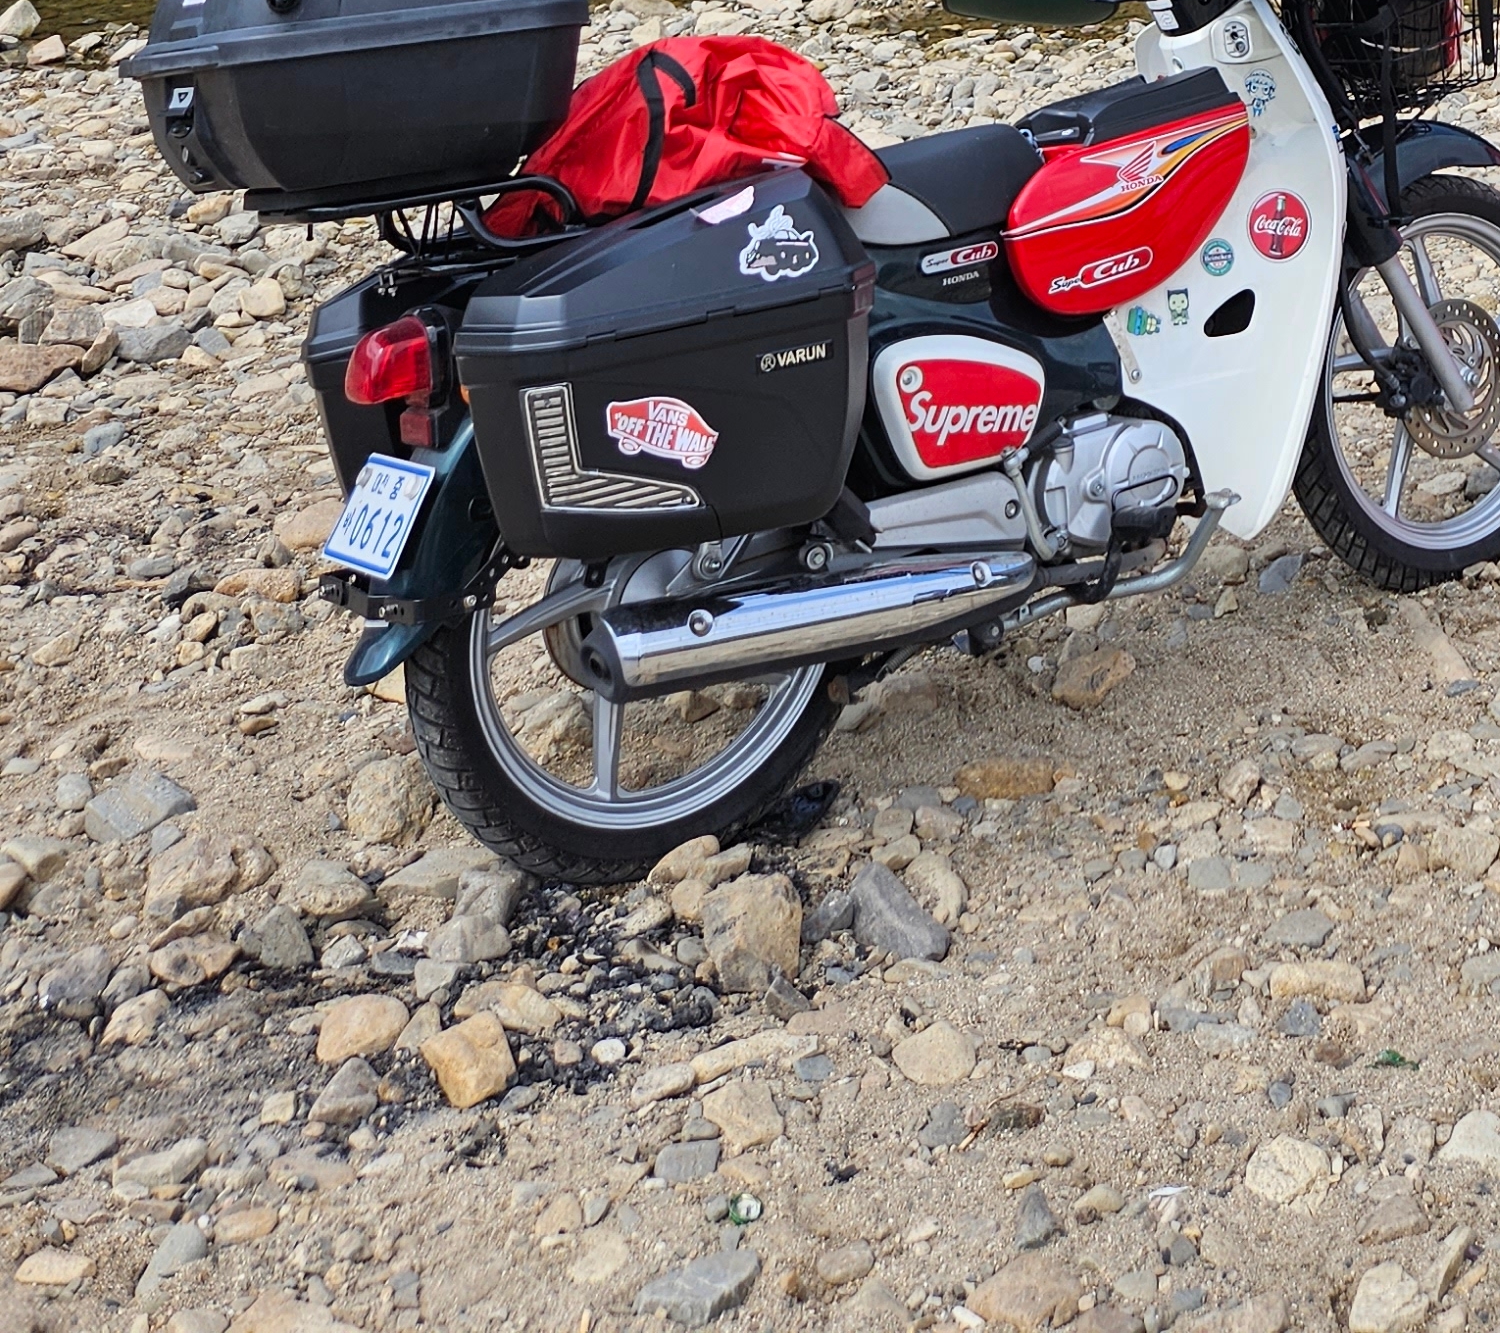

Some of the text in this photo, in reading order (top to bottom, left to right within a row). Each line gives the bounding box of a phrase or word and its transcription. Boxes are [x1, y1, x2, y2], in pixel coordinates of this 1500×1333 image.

[1120, 175, 1163, 192] HONDA
[957, 245, 992, 263] Cub
[942, 271, 980, 286] HONDA
[1051, 254, 1140, 292] Supe Cub
[777, 343, 826, 367] VARUN
[648, 400, 691, 426] VANS
[909, 391, 1038, 445] Supreme
[645, 419, 677, 450] THE
[389, 476, 405, 500] 중
[349, 503, 404, 559] 0612
